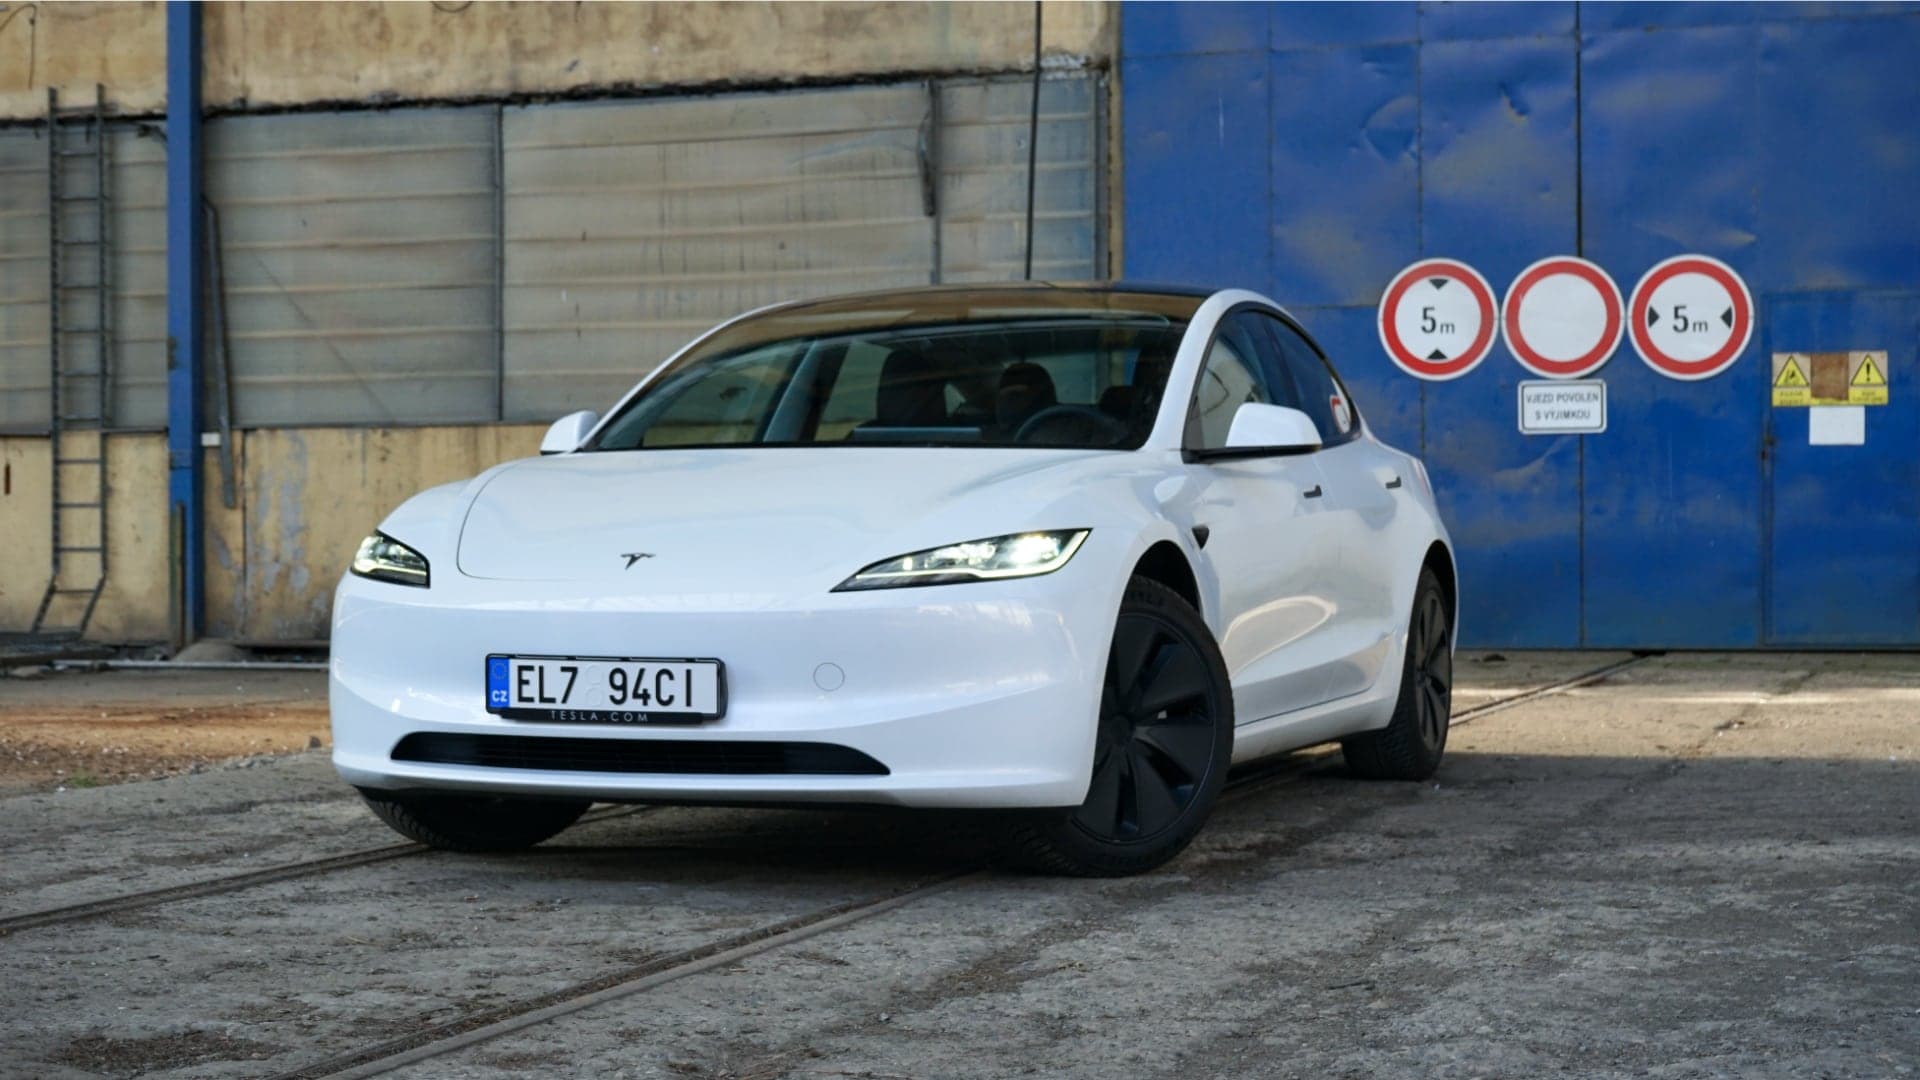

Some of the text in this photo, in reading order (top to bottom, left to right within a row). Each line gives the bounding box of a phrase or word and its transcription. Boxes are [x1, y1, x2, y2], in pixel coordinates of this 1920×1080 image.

[1526, 391, 1599, 404] VJEZD POVOLEN
[517, 664, 579, 704] EL7
[491, 689, 509, 702] CZ
[551, 710, 649, 722] TESLA.COM
